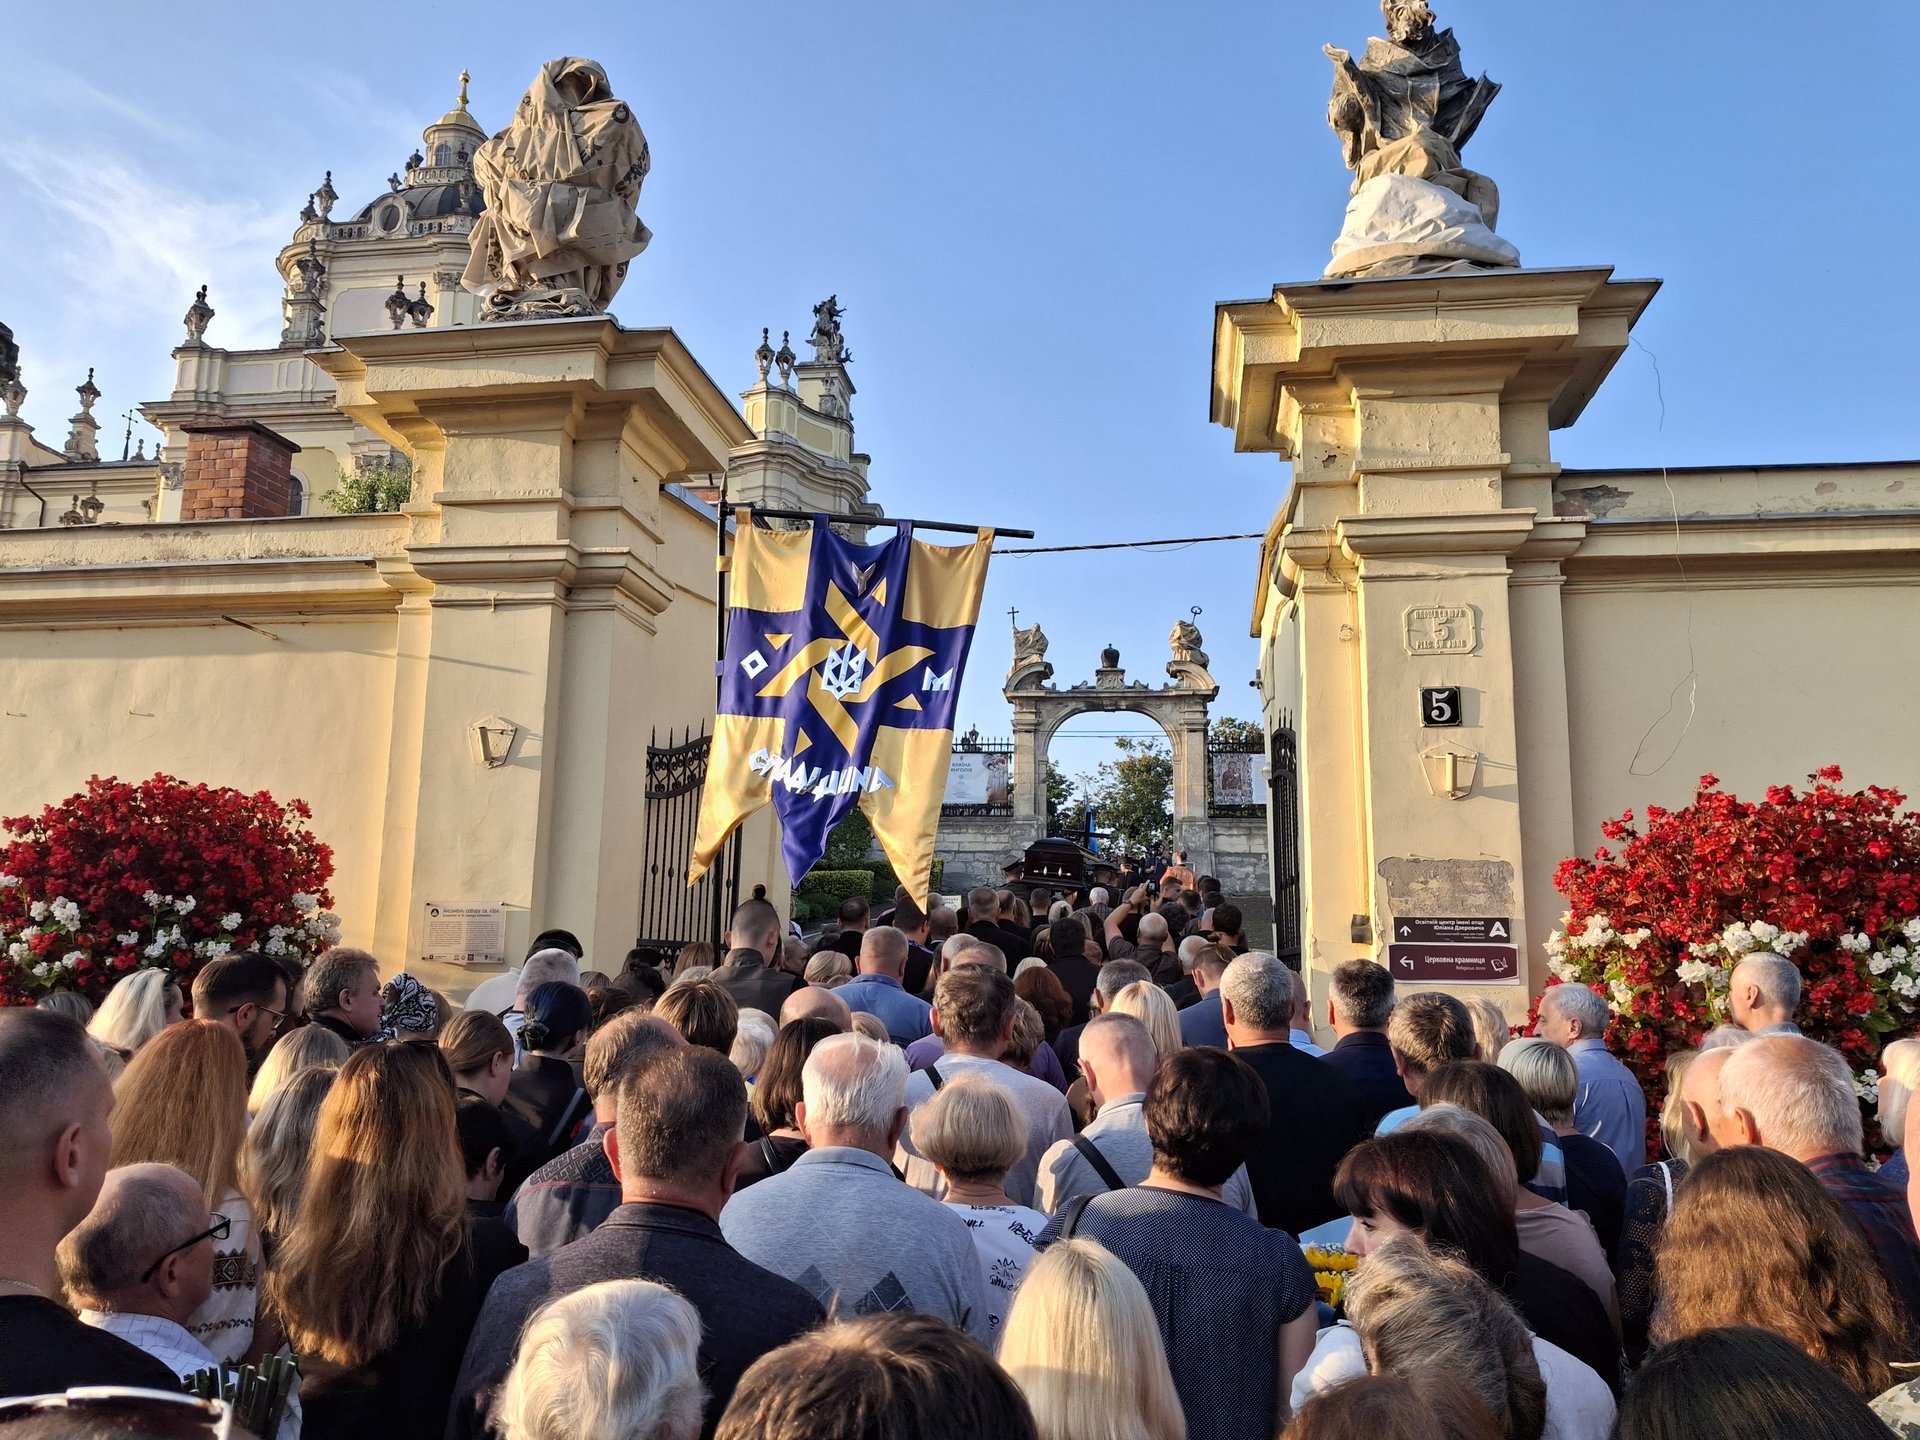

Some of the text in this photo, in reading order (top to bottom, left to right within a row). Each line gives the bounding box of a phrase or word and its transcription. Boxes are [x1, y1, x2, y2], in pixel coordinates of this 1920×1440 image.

[1431, 690, 1451, 721] 5
[1424, 955, 1486, 964] Церковна крамниця
